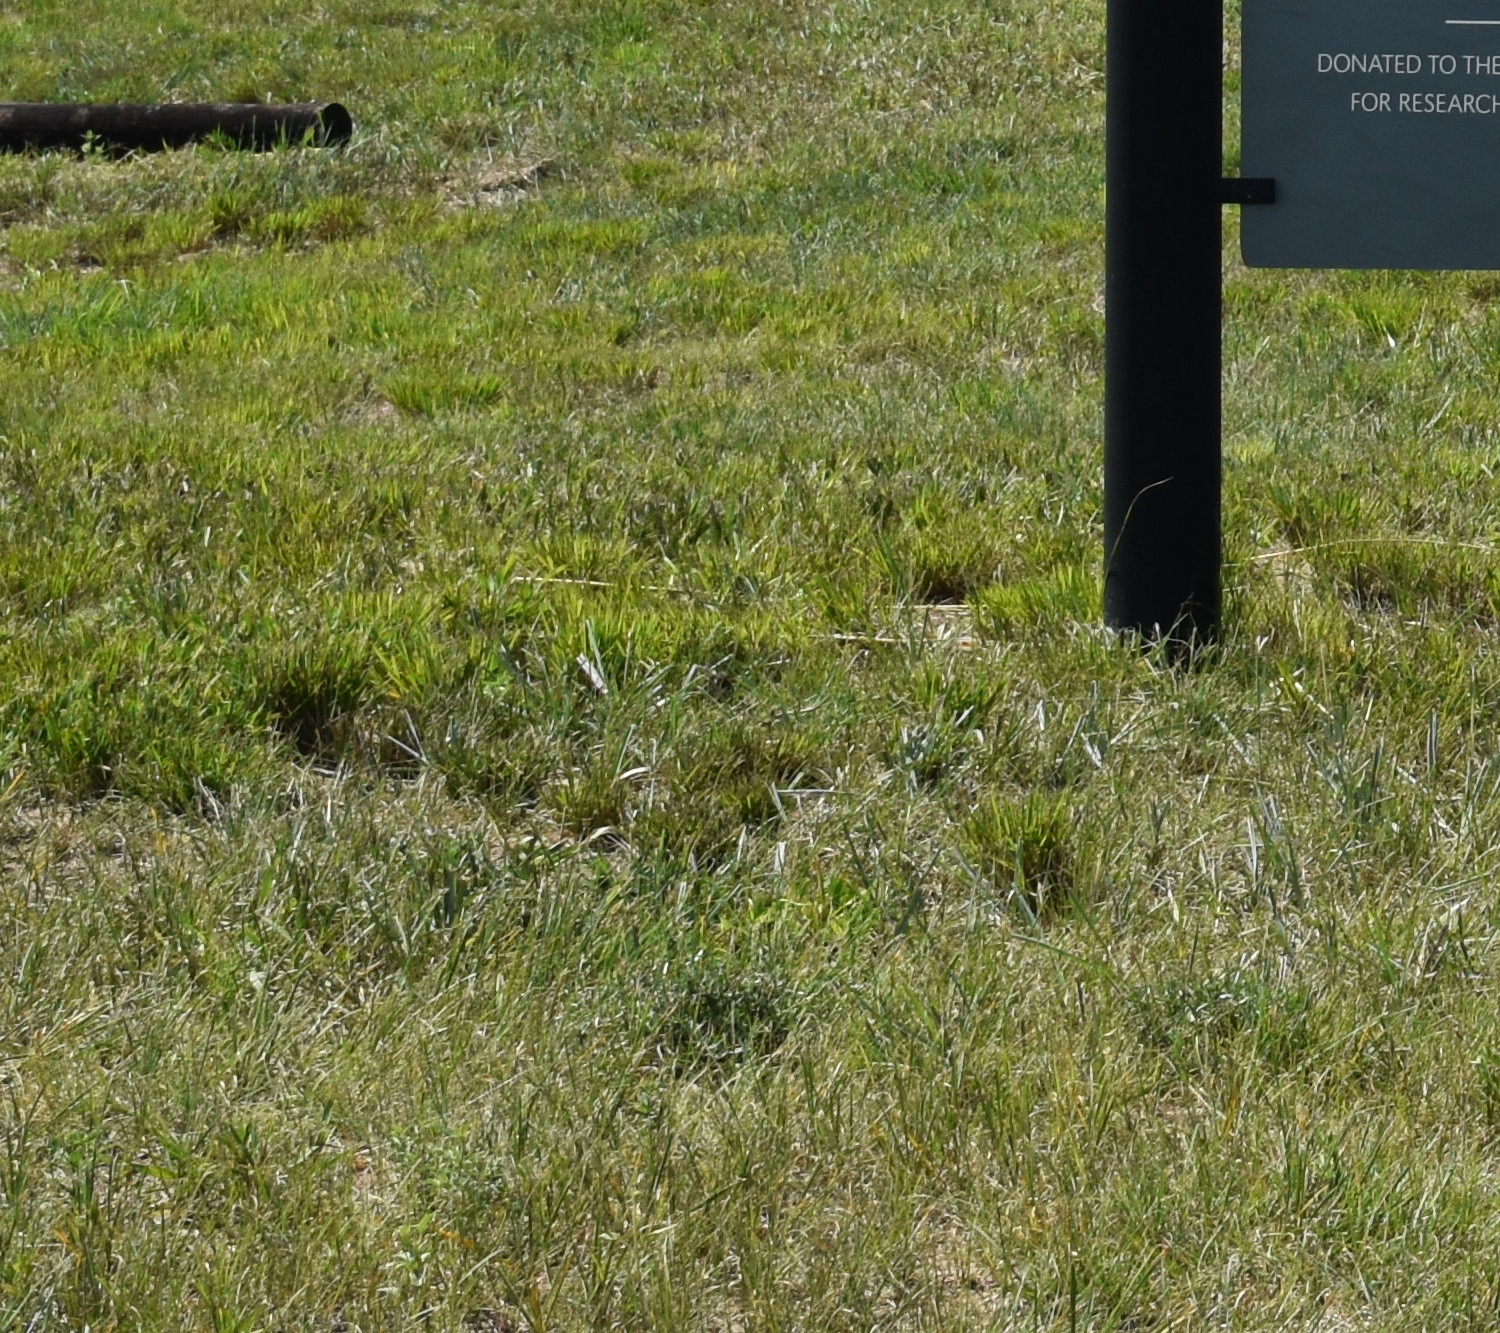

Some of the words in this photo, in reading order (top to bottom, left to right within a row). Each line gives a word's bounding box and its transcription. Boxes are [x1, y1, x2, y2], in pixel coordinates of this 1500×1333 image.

[1317, 53, 1422, 74] DONATED
[1427, 54, 1457, 75] TO
[1351, 92, 1392, 112] FOR
